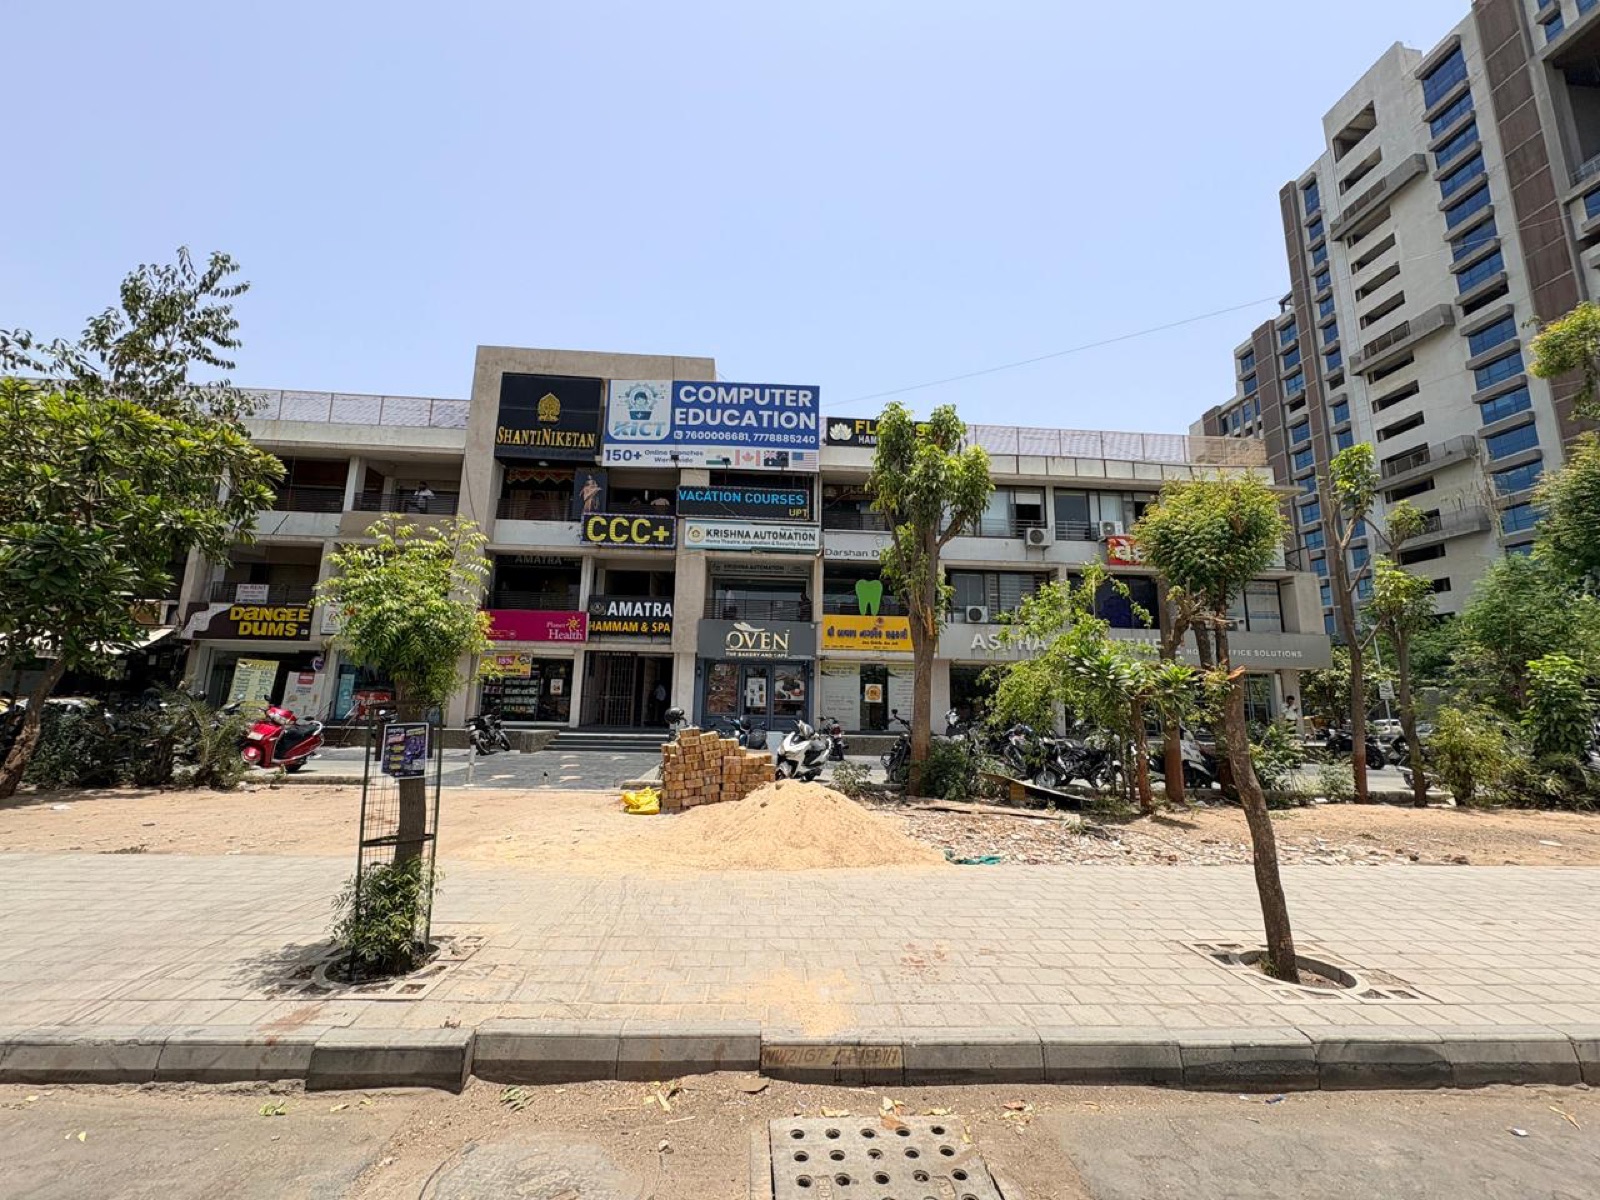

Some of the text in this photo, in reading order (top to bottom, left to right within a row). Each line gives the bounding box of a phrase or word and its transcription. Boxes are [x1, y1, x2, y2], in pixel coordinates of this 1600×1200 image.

[679, 385, 812, 407] COMPUTER
[674, 408, 816, 430] EDUCATION
[605, 449, 642, 461] 150+
[679, 489, 805, 505] VACATION COURSES
[587, 515, 670, 543] CCC+
[705, 528, 816, 541] KRISHNA AUTOMATION
[824, 548, 868, 557] Darshan
[607, 600, 672, 617] AMATRA
[548, 628, 583, 641] Health
[588, 620, 671, 633] HAMMAM & SPA
[726, 630, 790, 651] OVEN
